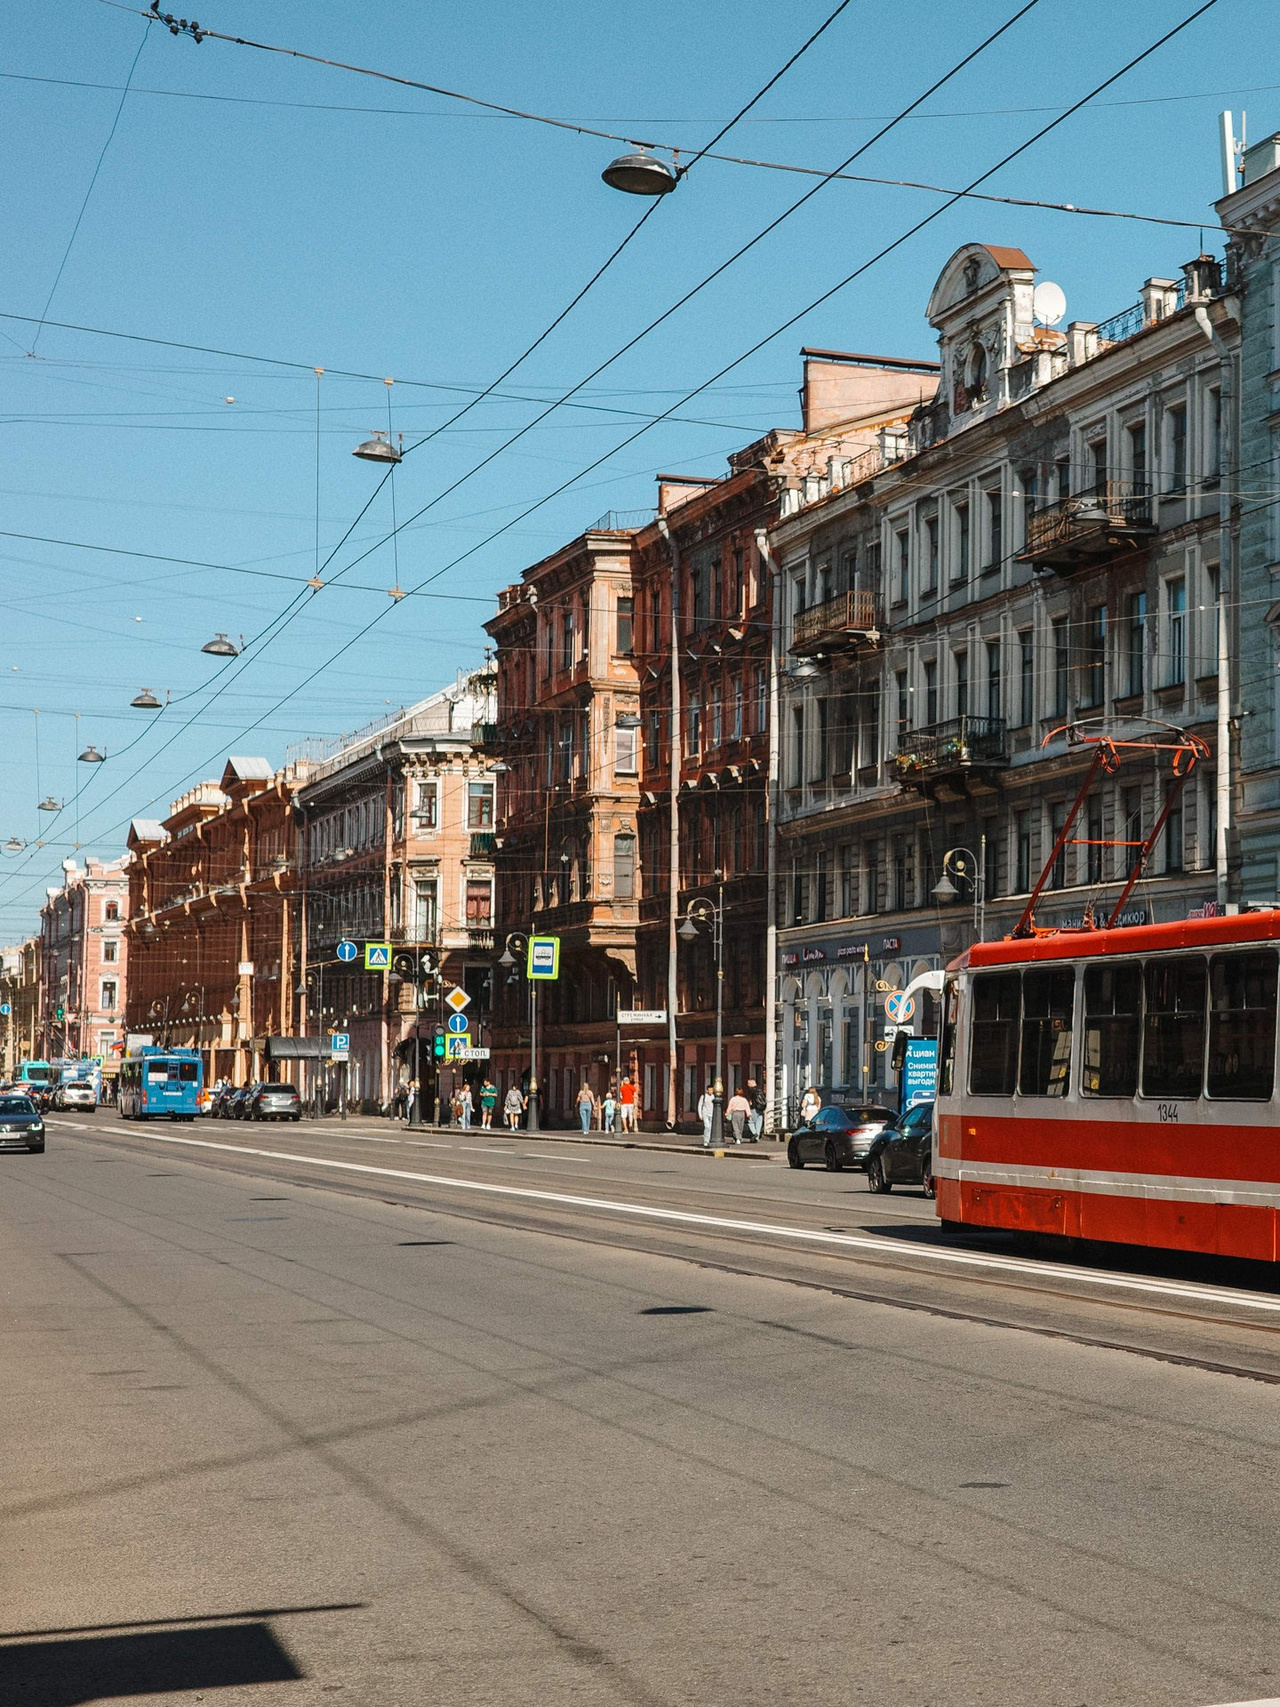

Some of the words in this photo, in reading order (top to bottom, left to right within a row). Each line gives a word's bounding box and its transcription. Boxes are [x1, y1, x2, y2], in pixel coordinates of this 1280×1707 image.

[883, 939, 899, 950] ПАСТА
[913, 1050, 935, 1058] циан
[1157, 1103, 1179, 1122] 1344
